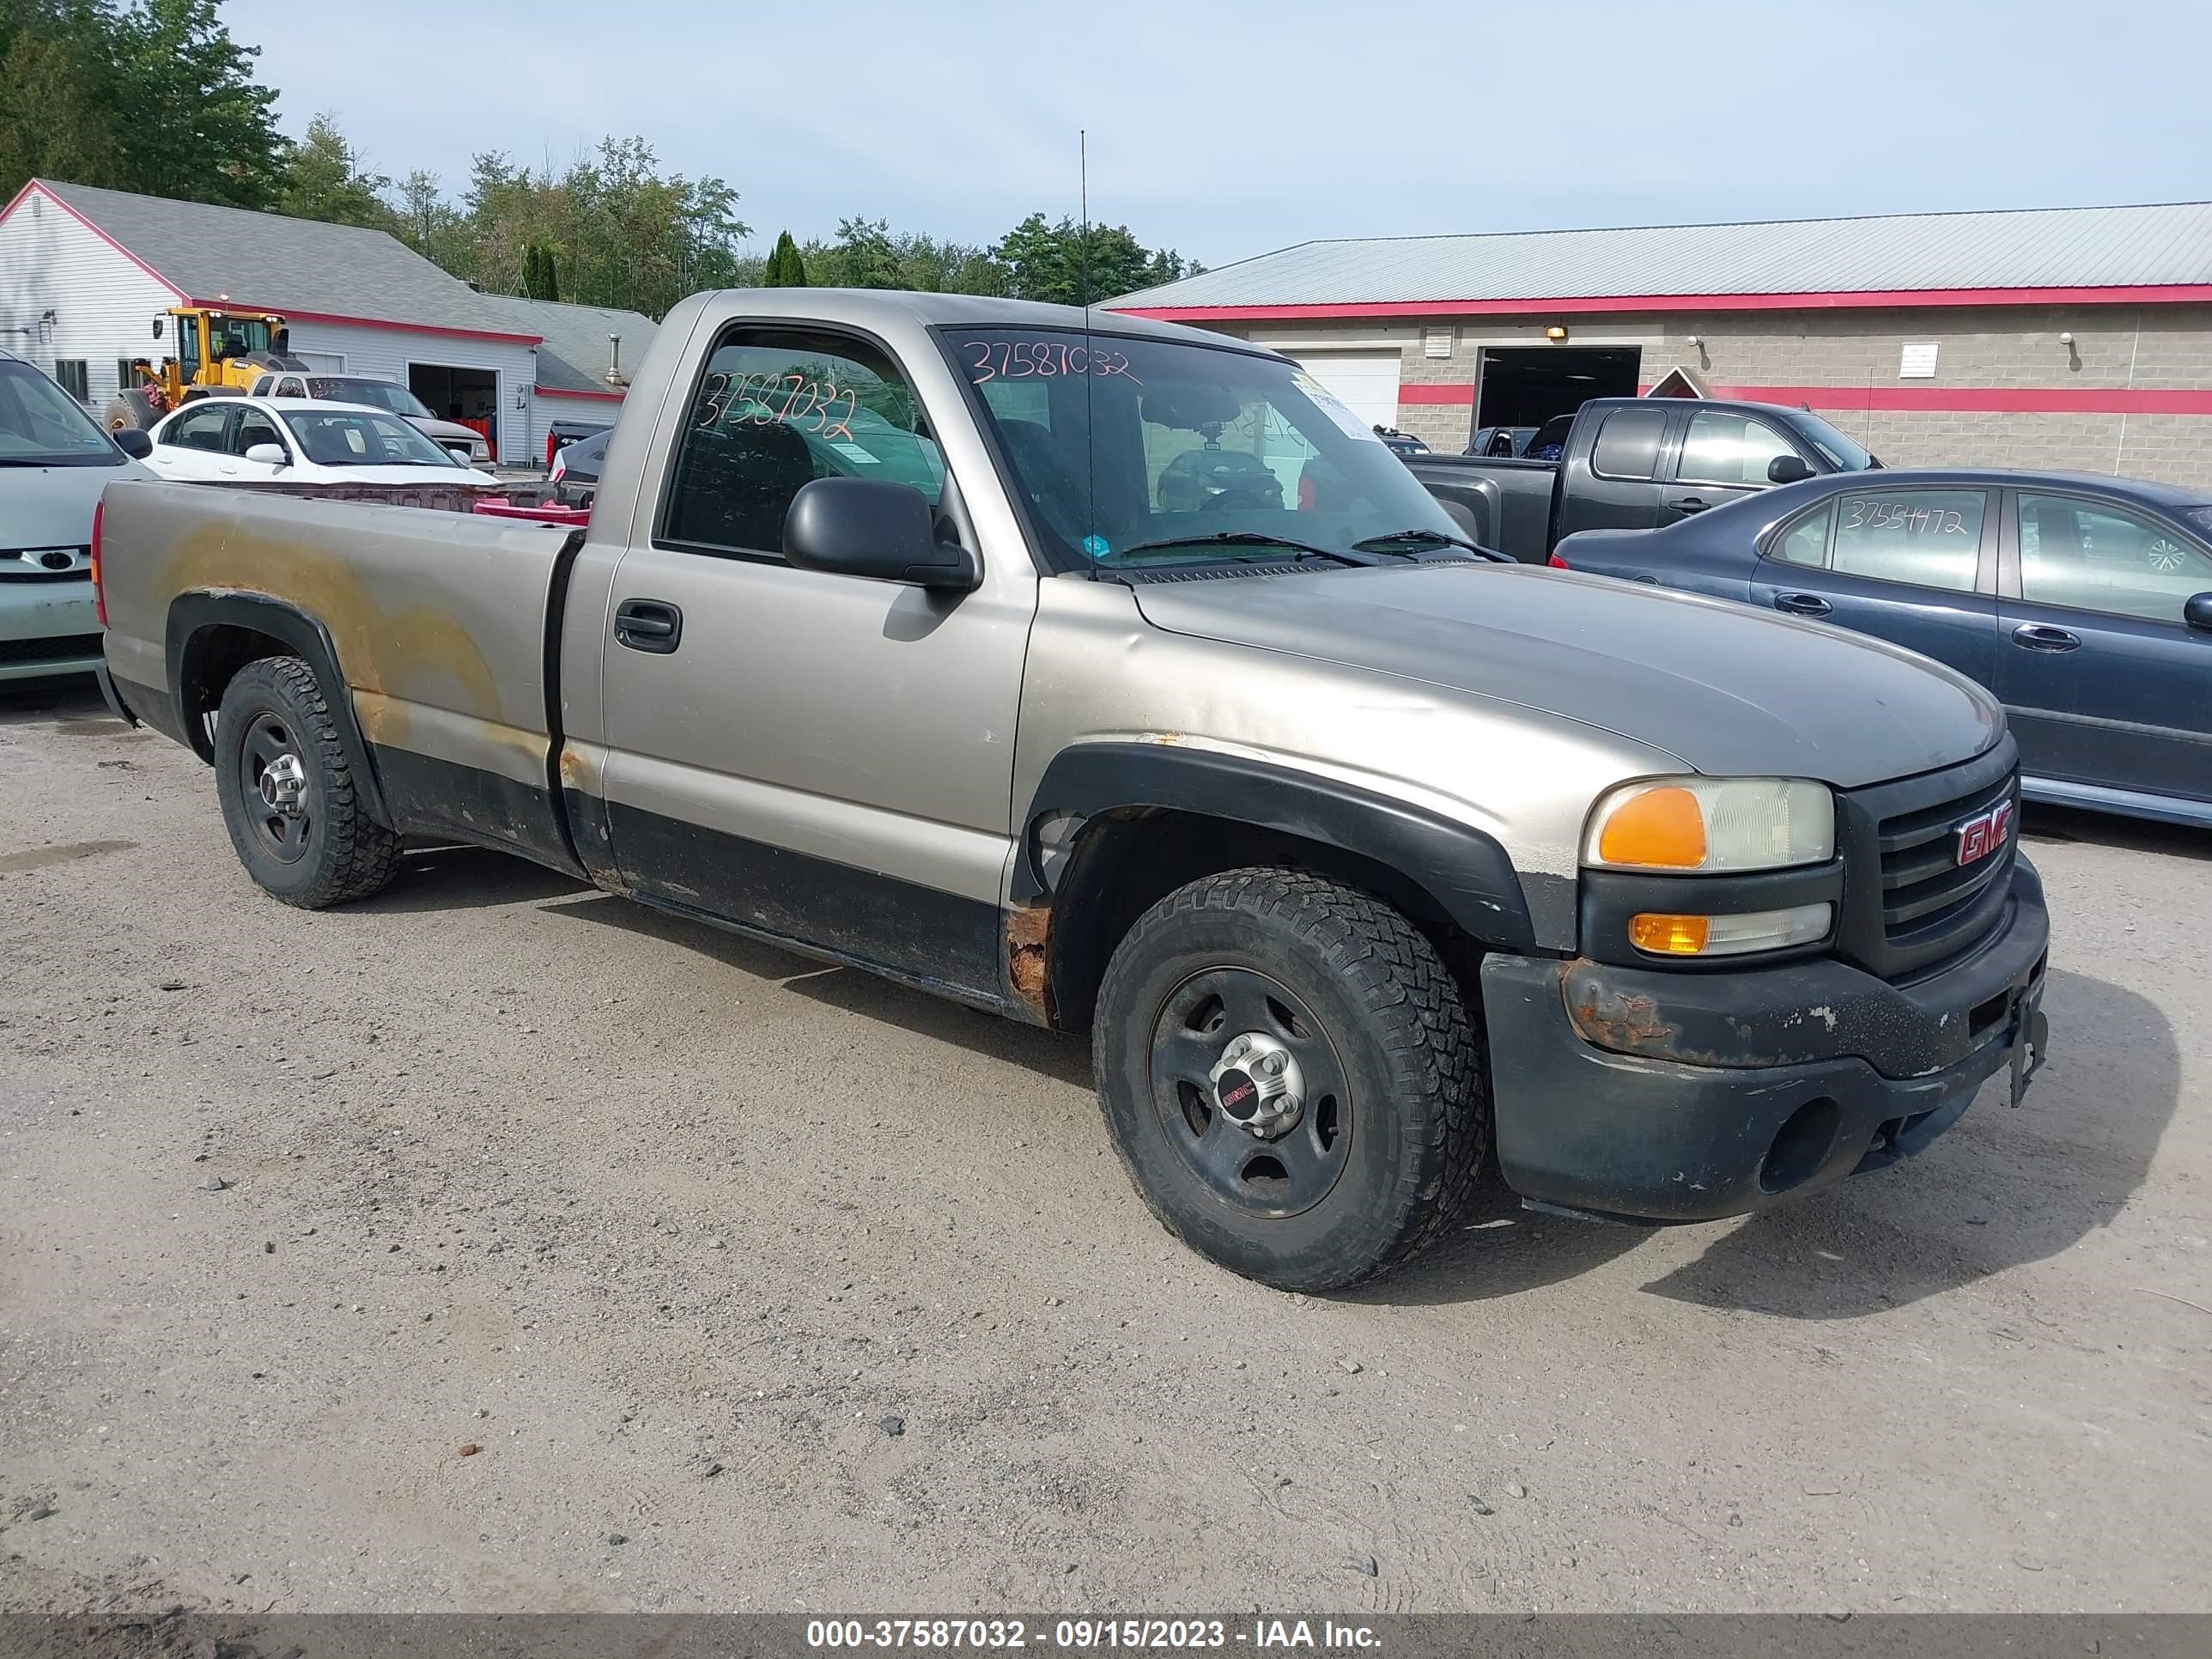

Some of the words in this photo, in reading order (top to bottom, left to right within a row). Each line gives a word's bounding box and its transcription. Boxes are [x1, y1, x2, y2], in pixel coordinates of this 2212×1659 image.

[963, 341, 1145, 386] 37587032
[700, 372, 854, 443] 37587032
[1845, 501, 1968, 535] 37554472
[1957, 799, 2013, 866] GMC
[1222, 1081, 1255, 1107] GMC
